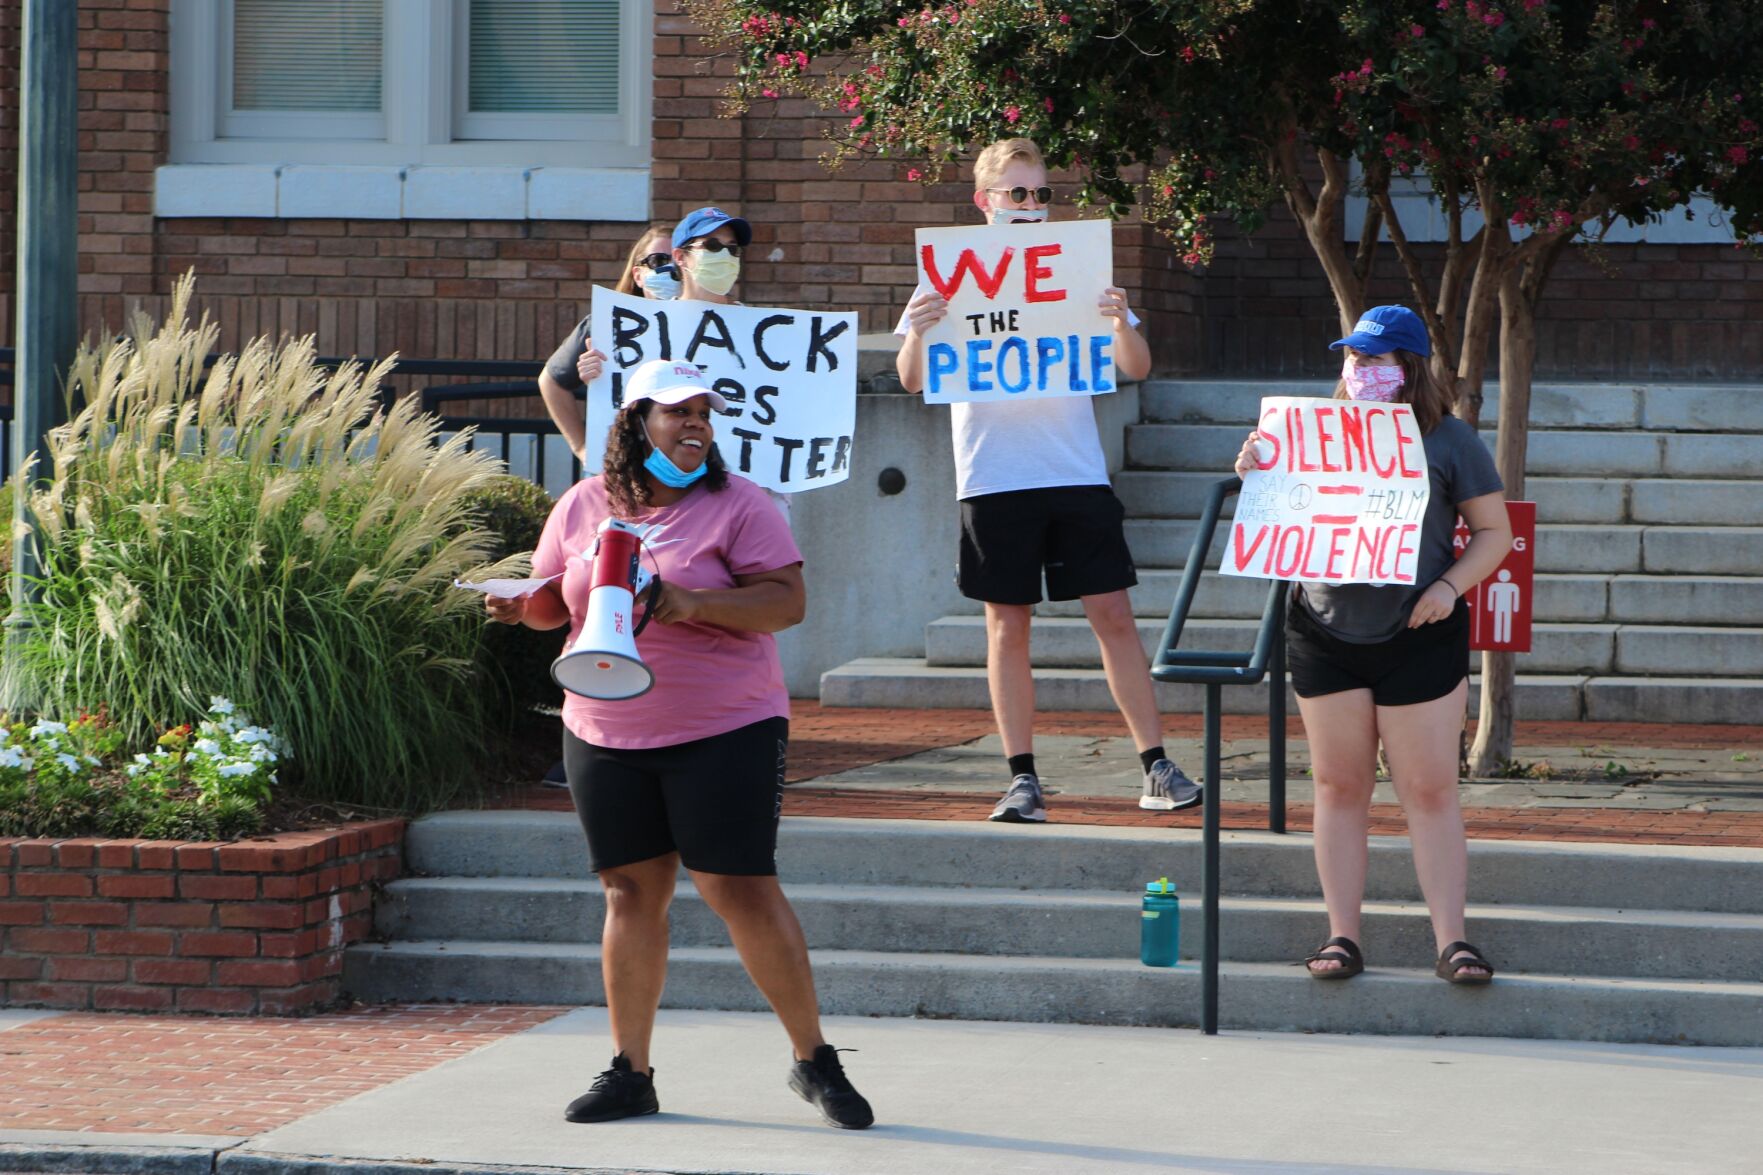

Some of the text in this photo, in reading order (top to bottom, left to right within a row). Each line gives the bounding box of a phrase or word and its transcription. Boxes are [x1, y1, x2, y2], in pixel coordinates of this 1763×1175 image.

[921, 243, 1067, 303] WE
[965, 309, 1020, 335] THE
[928, 334, 1113, 394] PEOPLE
[1256, 406, 1423, 478] SILENCE
[1364, 489, 1427, 521] #BLM
[1234, 522, 1418, 581] VIOLENCE
